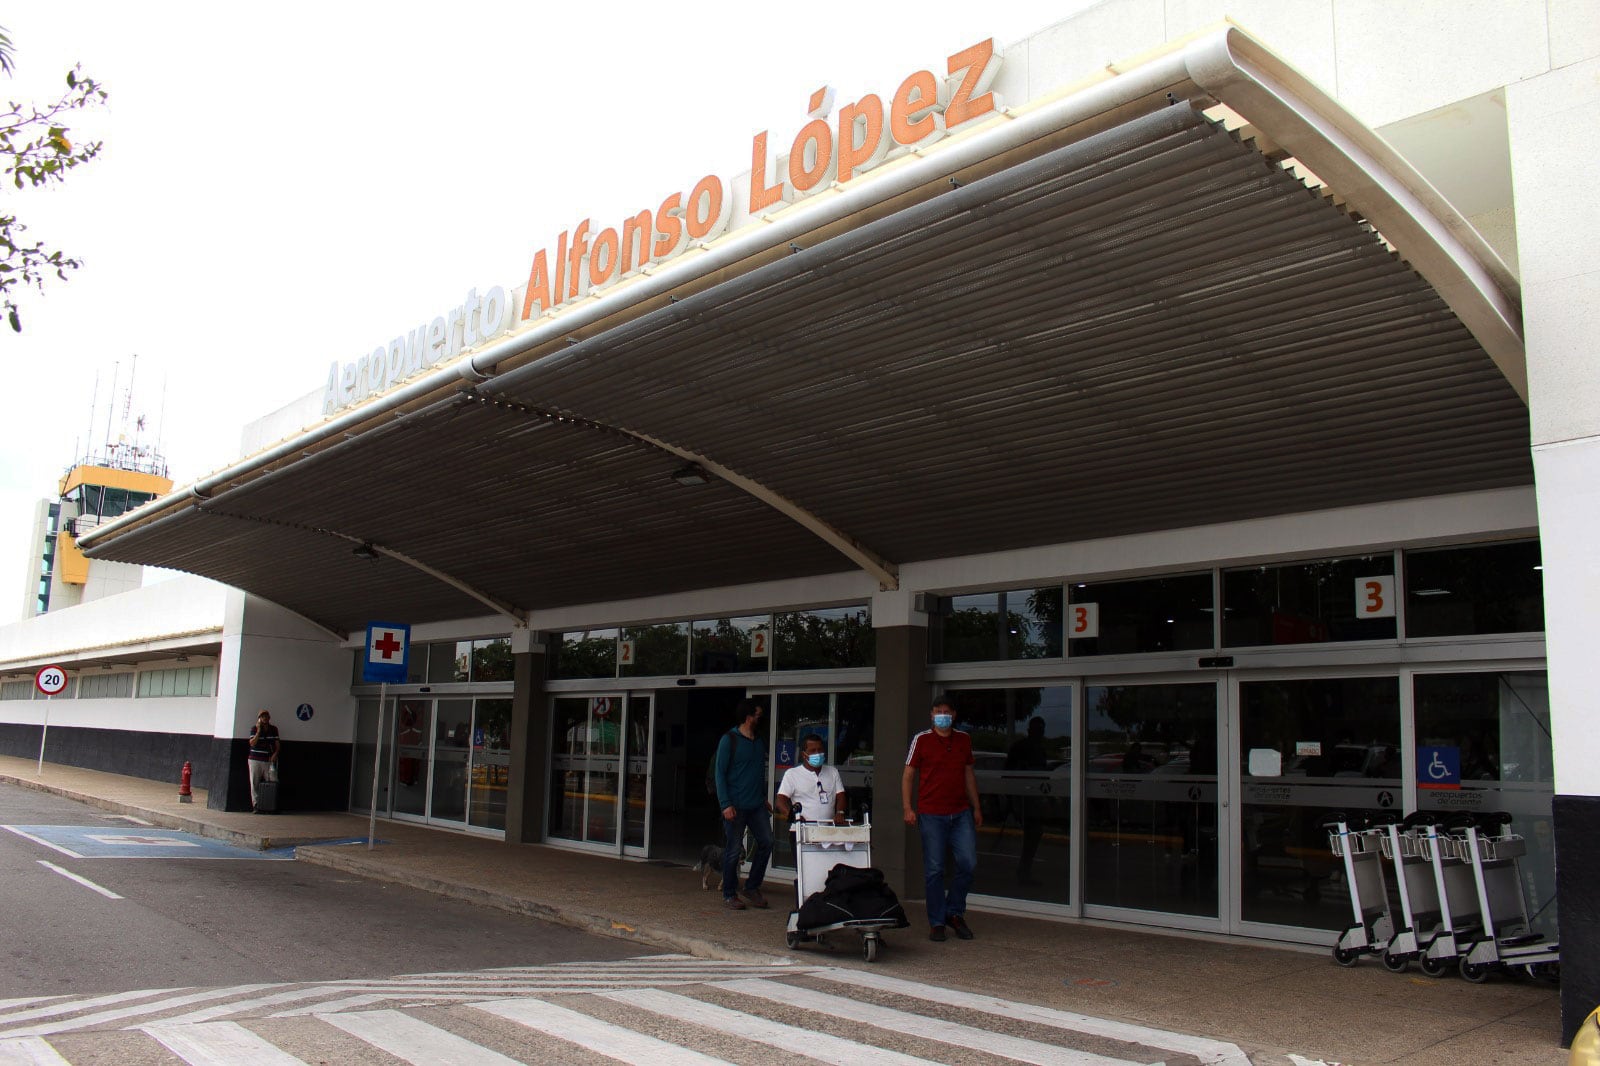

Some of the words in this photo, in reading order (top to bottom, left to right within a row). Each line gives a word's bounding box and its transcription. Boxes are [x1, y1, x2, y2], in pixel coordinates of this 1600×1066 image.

[321, 284, 510, 416] Aeropuerto
[521, 174, 725, 321] Alfonso
[749, 36, 998, 215] López
[1364, 581, 1384, 613] 3
[1074, 607, 1088, 633] 3
[622, 643, 630, 661] 2
[754, 633, 765, 653] 2
[44, 674, 60, 686] 20
[1429, 790, 1483, 800] aeropuertos
[1437, 797, 1449, 805] de
[1450, 798, 1482, 806] oriente
